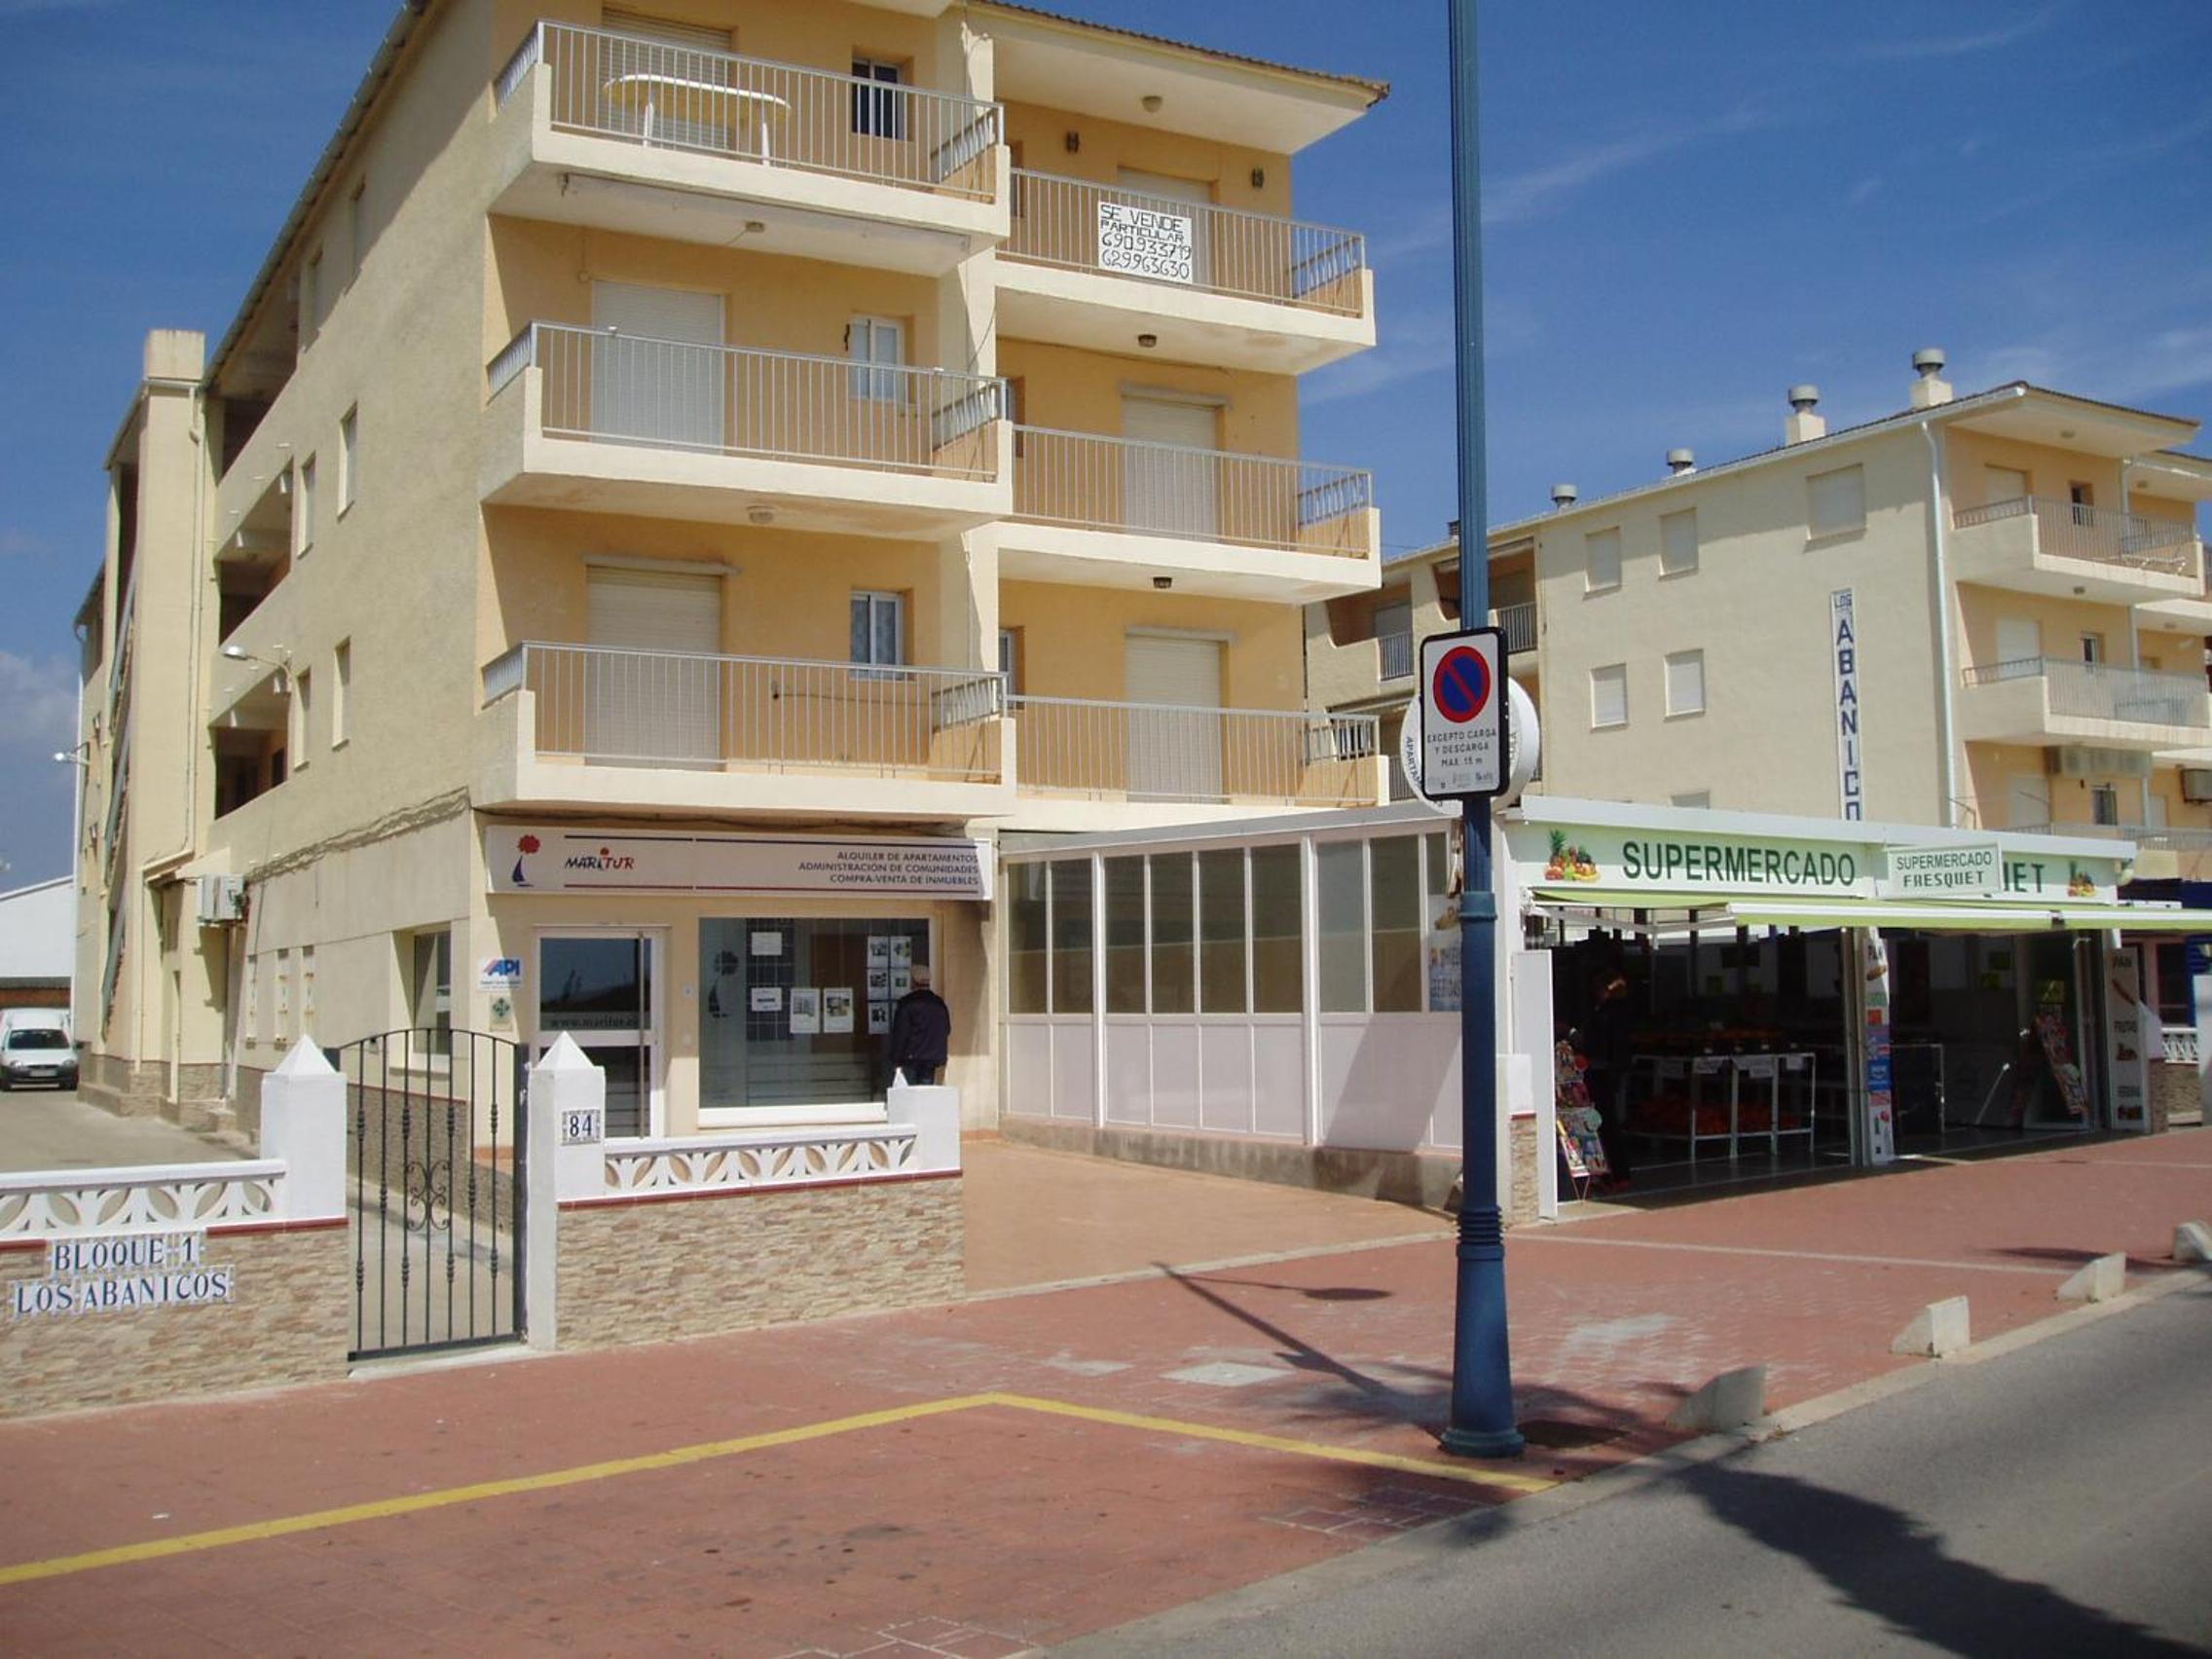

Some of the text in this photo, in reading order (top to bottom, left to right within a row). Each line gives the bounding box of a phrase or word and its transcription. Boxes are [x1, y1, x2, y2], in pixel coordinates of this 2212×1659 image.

[1100, 204, 1184, 234] SE VENDE
[1100, 219, 1185, 243] PARTICULAR
[1426, 728, 1496, 744] EXCEPTO CARGA
[1434, 742, 1490, 756] Y DESCARGA
[837, 851, 978, 864] ALQUILER DE APARTAMENTOS
[1622, 840, 1856, 887] SUPERMERCADO
[1897, 851, 1992, 870] SUPERMERCADO
[890, 863, 902, 872] DE
[904, 864, 978, 874] COMUNIDADES
[910, 875, 922, 885] DE
[925, 876, 978, 886] INMUEBLES
[1903, 870, 1984, 888] FRESQUET
[484, 959, 520, 977] API
[570, 1114, 592, 1137] 84
[54, 1236, 194, 1272] BLOQUE 1
[17, 1272, 227, 1314] LOS ABANICOS
